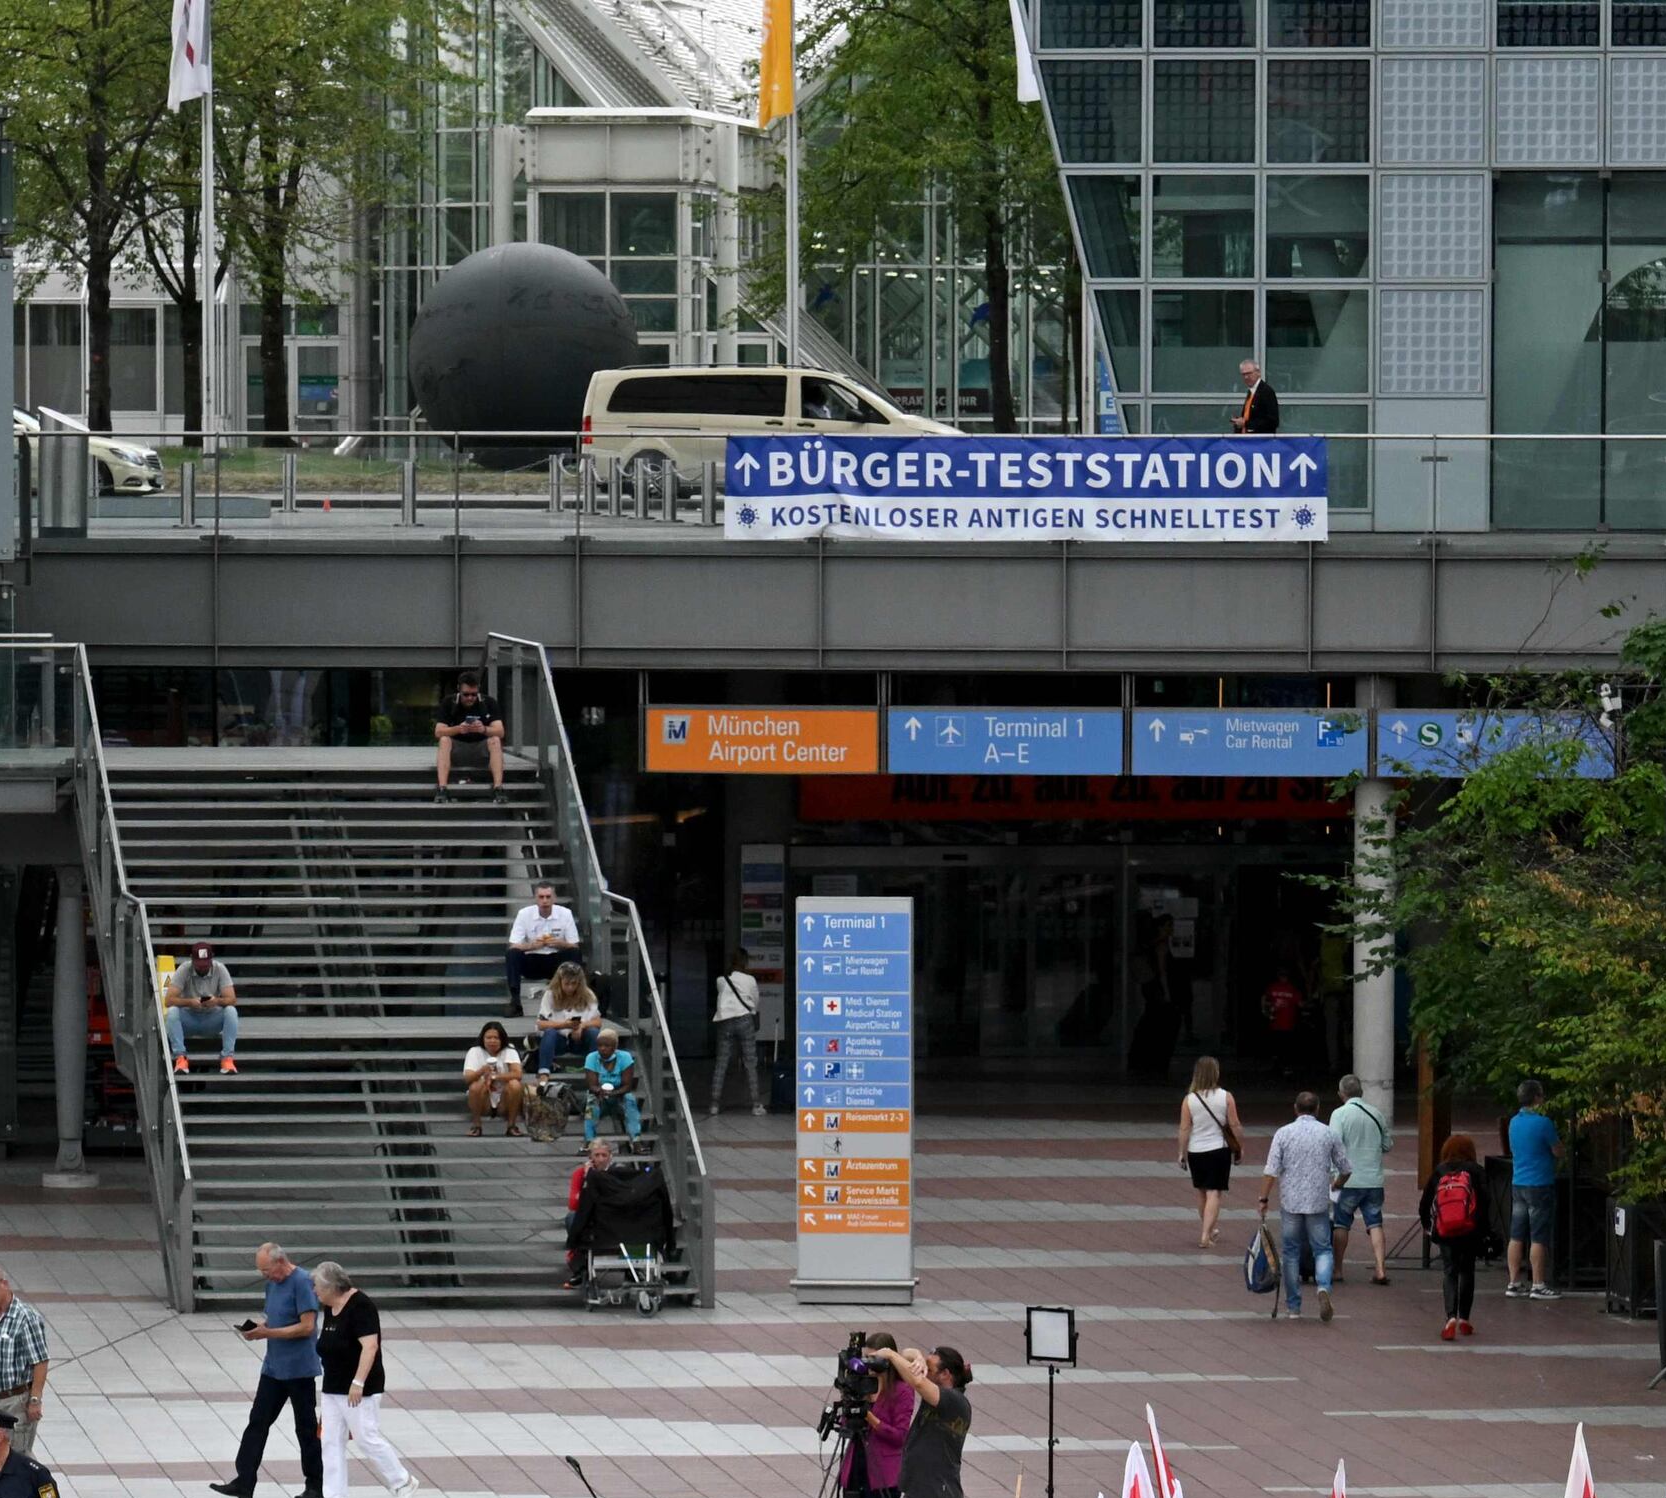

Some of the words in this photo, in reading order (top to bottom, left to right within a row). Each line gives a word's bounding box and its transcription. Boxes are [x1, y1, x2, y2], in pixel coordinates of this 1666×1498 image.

[768, 440, 1281, 489] BÜRGER-TESTSTATION
[771, 503, 958, 529] KOSTENLOSER
[968, 507, 1085, 530] ANTIGEN
[1095, 507, 1281, 530] SCHNELLTEST
[708, 715, 801, 737] München
[984, 716, 1068, 738] Terminal
[1077, 717, 1084, 738] 1
[1226, 717, 1301, 742] Mietwagen
[1226, 734, 1248, 750] Car
[1252, 734, 1293, 750] Rental
[709, 741, 777, 766] Airport
[783, 741, 848, 763] Center
[823, 915, 876, 929] Terminal
[881, 916, 886, 929] 1
[845, 957, 889, 967] Mietwagen
[845, 967, 858, 976] Car
[860, 967, 885, 976] Rental
[845, 996, 863, 1005] Med.
[866, 996, 890, 1005] Dienst
[845, 1009, 874, 1018] Medical
[876, 1009, 903, 1019] Station
[845, 1021, 891, 1031] AirportClinic
[845, 1037, 882, 1047] Apotheke
[845, 1048, 884, 1057] Pharmacy
[845, 1087, 883, 1097] Kirchliche
[845, 1098, 875, 1106] Dienste
[845, 1112, 889, 1121] Reisemarkt
[845, 1159, 899, 1171] Ärztezentrum
[845, 1185, 875, 1196] Service
[876, 1185, 900, 1195] Markt
[846, 1196, 900, 1206] Ausweisstelle
